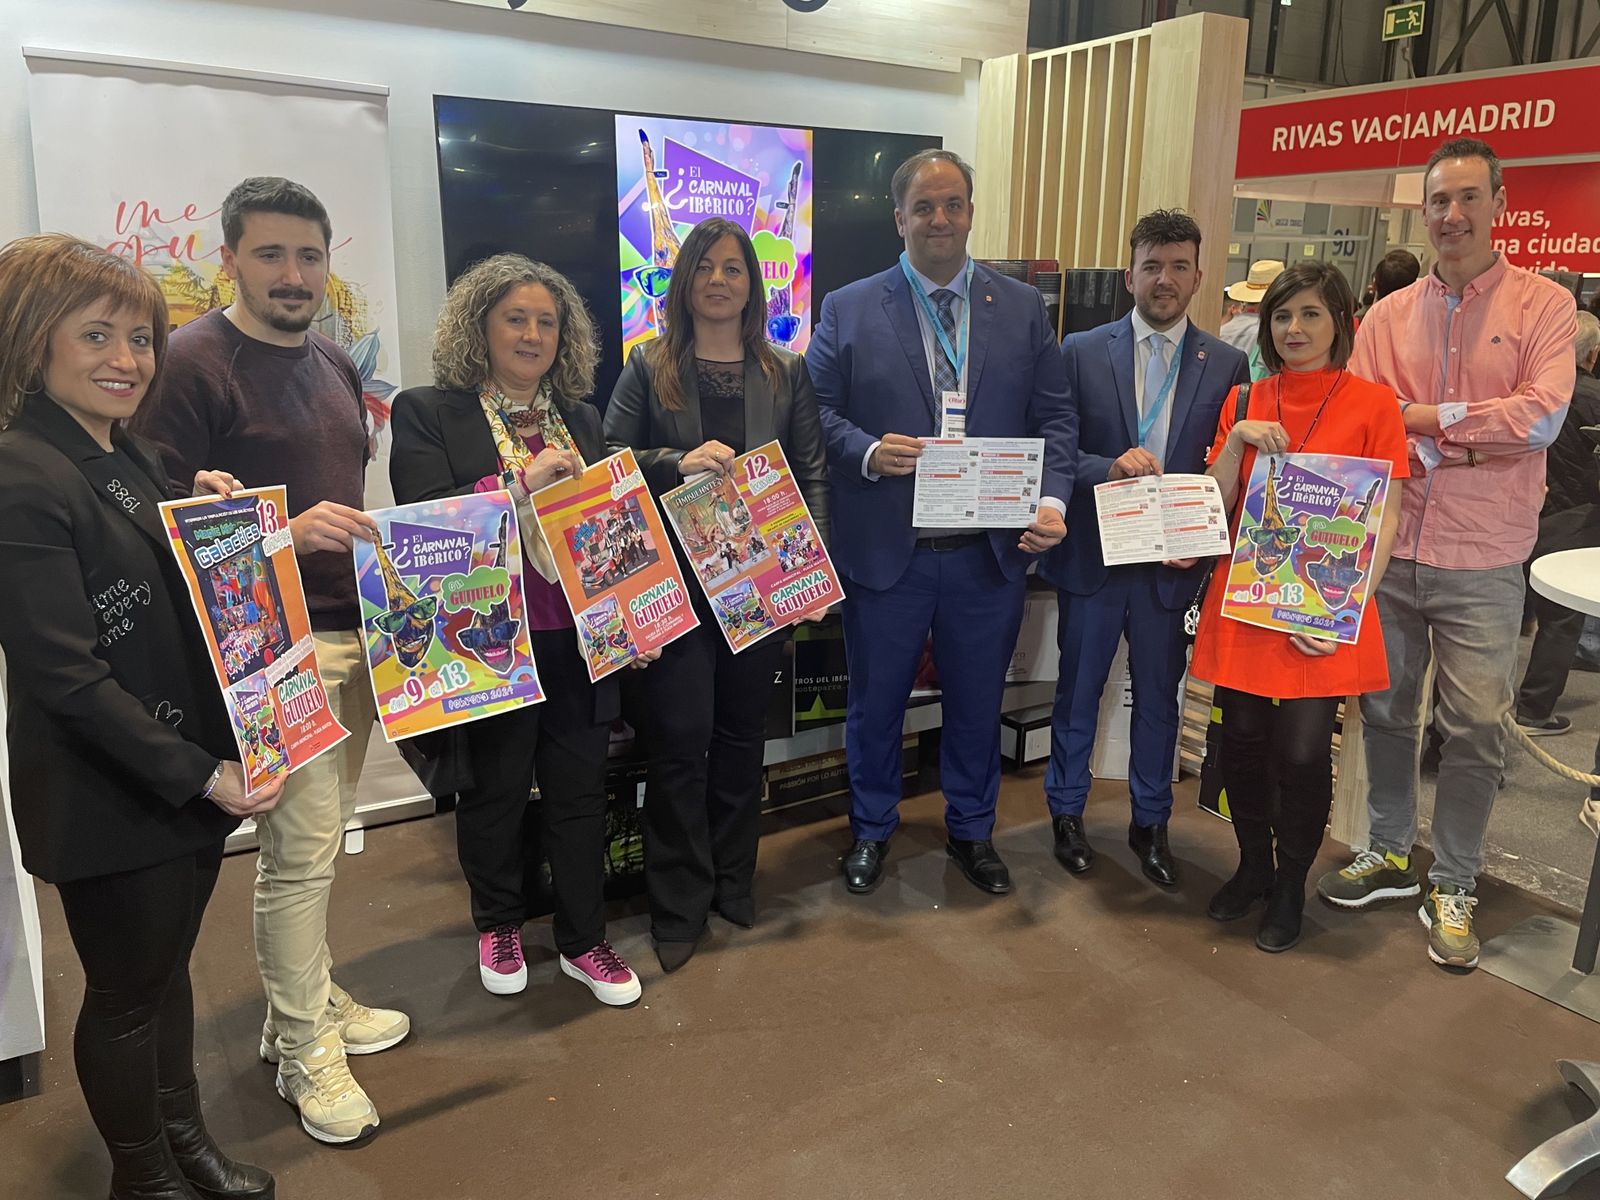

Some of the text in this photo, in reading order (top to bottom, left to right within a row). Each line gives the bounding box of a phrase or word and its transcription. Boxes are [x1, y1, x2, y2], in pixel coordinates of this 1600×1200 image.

[1272, 99, 1556, 151] RIVAS VACIAMADRID
[689, 179, 753, 197] CARNAVAL
[1332, 228, 1356, 257] 9b
[1490, 238, 1520, 254] na
[609, 458, 626, 484] 11
[745, 455, 769, 480] 12
[1293, 482, 1340, 496] CARNAVAL
[257, 499, 277, 535] 13
[413, 537, 469, 554] CARNAVAL
[1310, 528, 1359, 548] GUIJUELO
[449, 583, 504, 606] GUIJUELO
[630, 577, 678, 612] CARNAVAL
[771, 570, 828, 604] CARNAVAL
[776, 579, 833, 616] GUIJUELO
[1251, 582, 1265, 603] 9
[1280, 583, 1304, 605] 13
[103, 581, 151, 624] every
[634, 588, 683, 628] GUIJUELO
[100, 617, 134, 647] one
[278, 668, 317, 705] CARNAVAL
[405, 678, 425, 706] 9
[439, 661, 469, 692] 13
[490, 686, 514, 700] 2024
[794, 677, 814, 685] TROS
[833, 674, 851, 682] IBÉR
[282, 685, 325, 728] GUIJUELO
